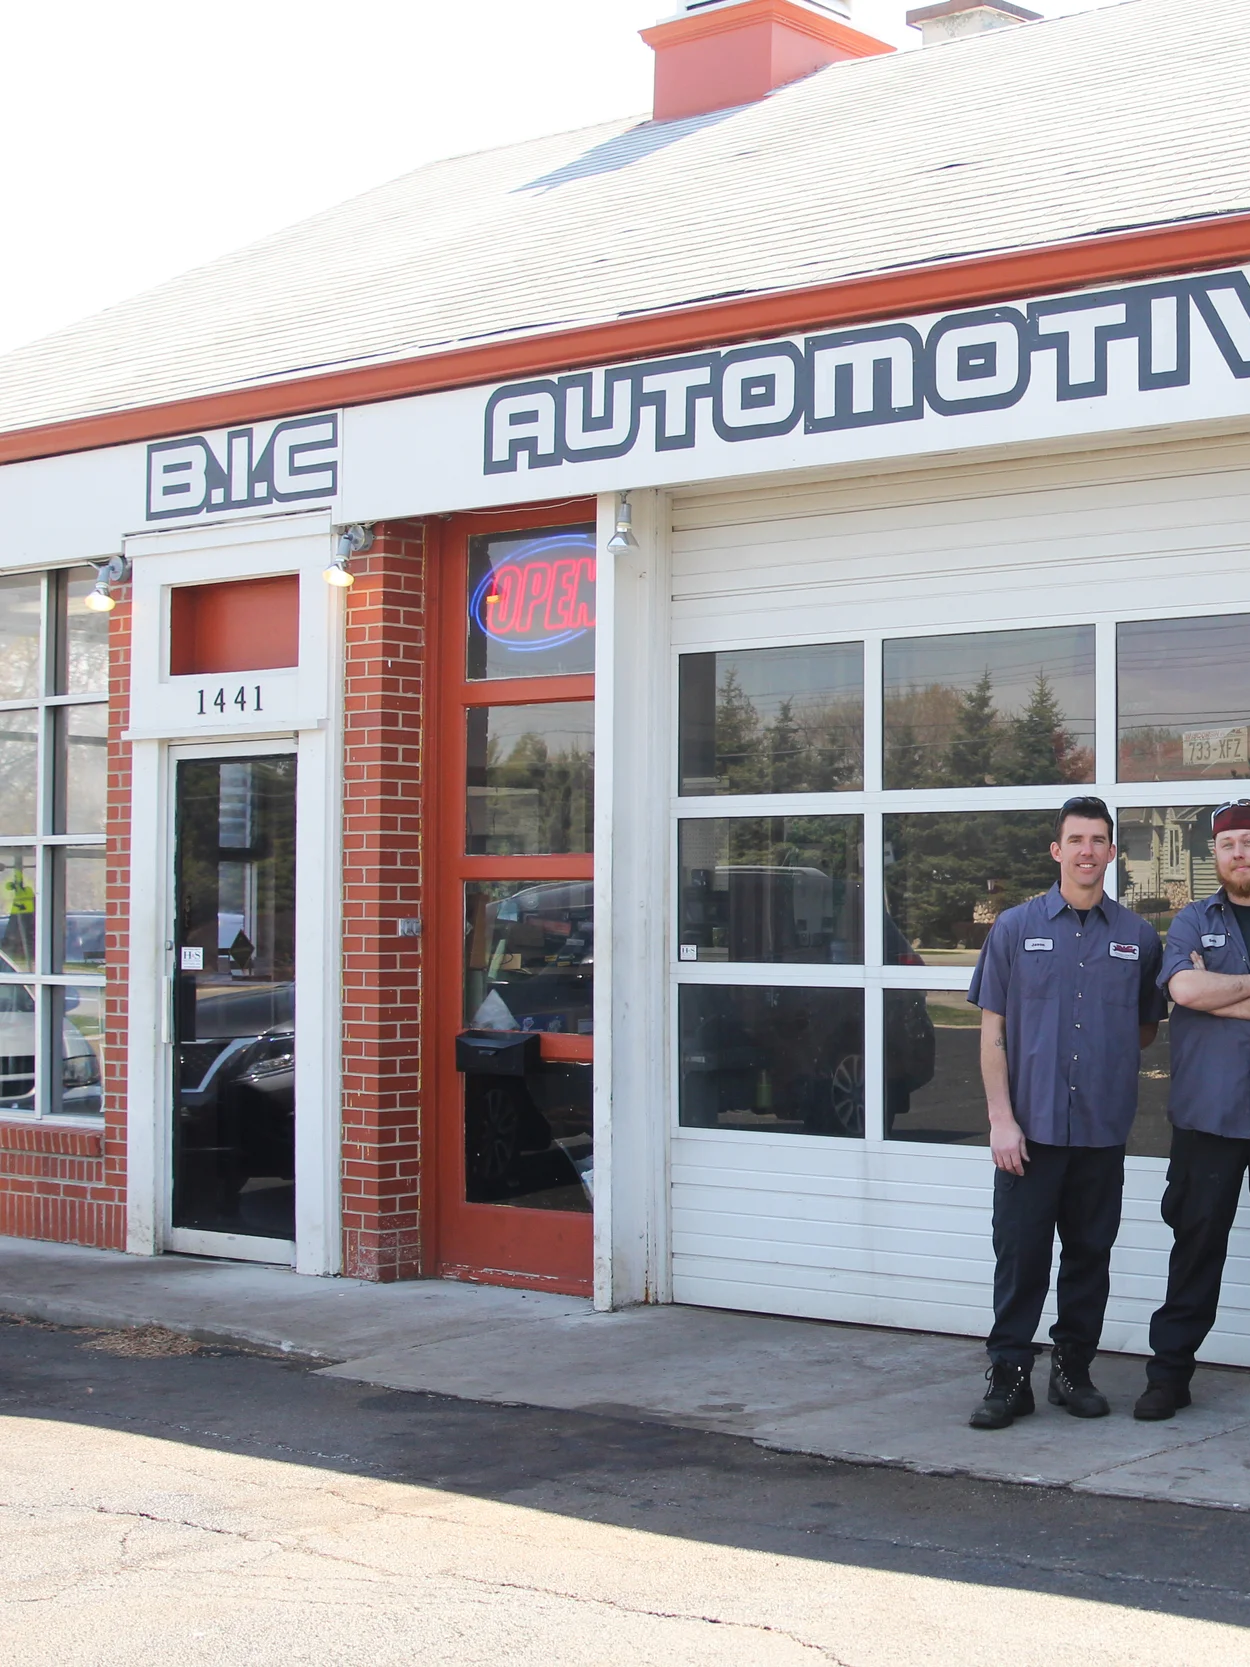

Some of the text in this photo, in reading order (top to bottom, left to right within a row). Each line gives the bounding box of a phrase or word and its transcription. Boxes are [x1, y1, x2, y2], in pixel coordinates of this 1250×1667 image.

[146, 413, 338, 521] B.I.C
[487, 558, 597, 634] OPEN
[197, 685, 263, 715] 1441
[1188, 738, 1242, 761] 733-XFZ
